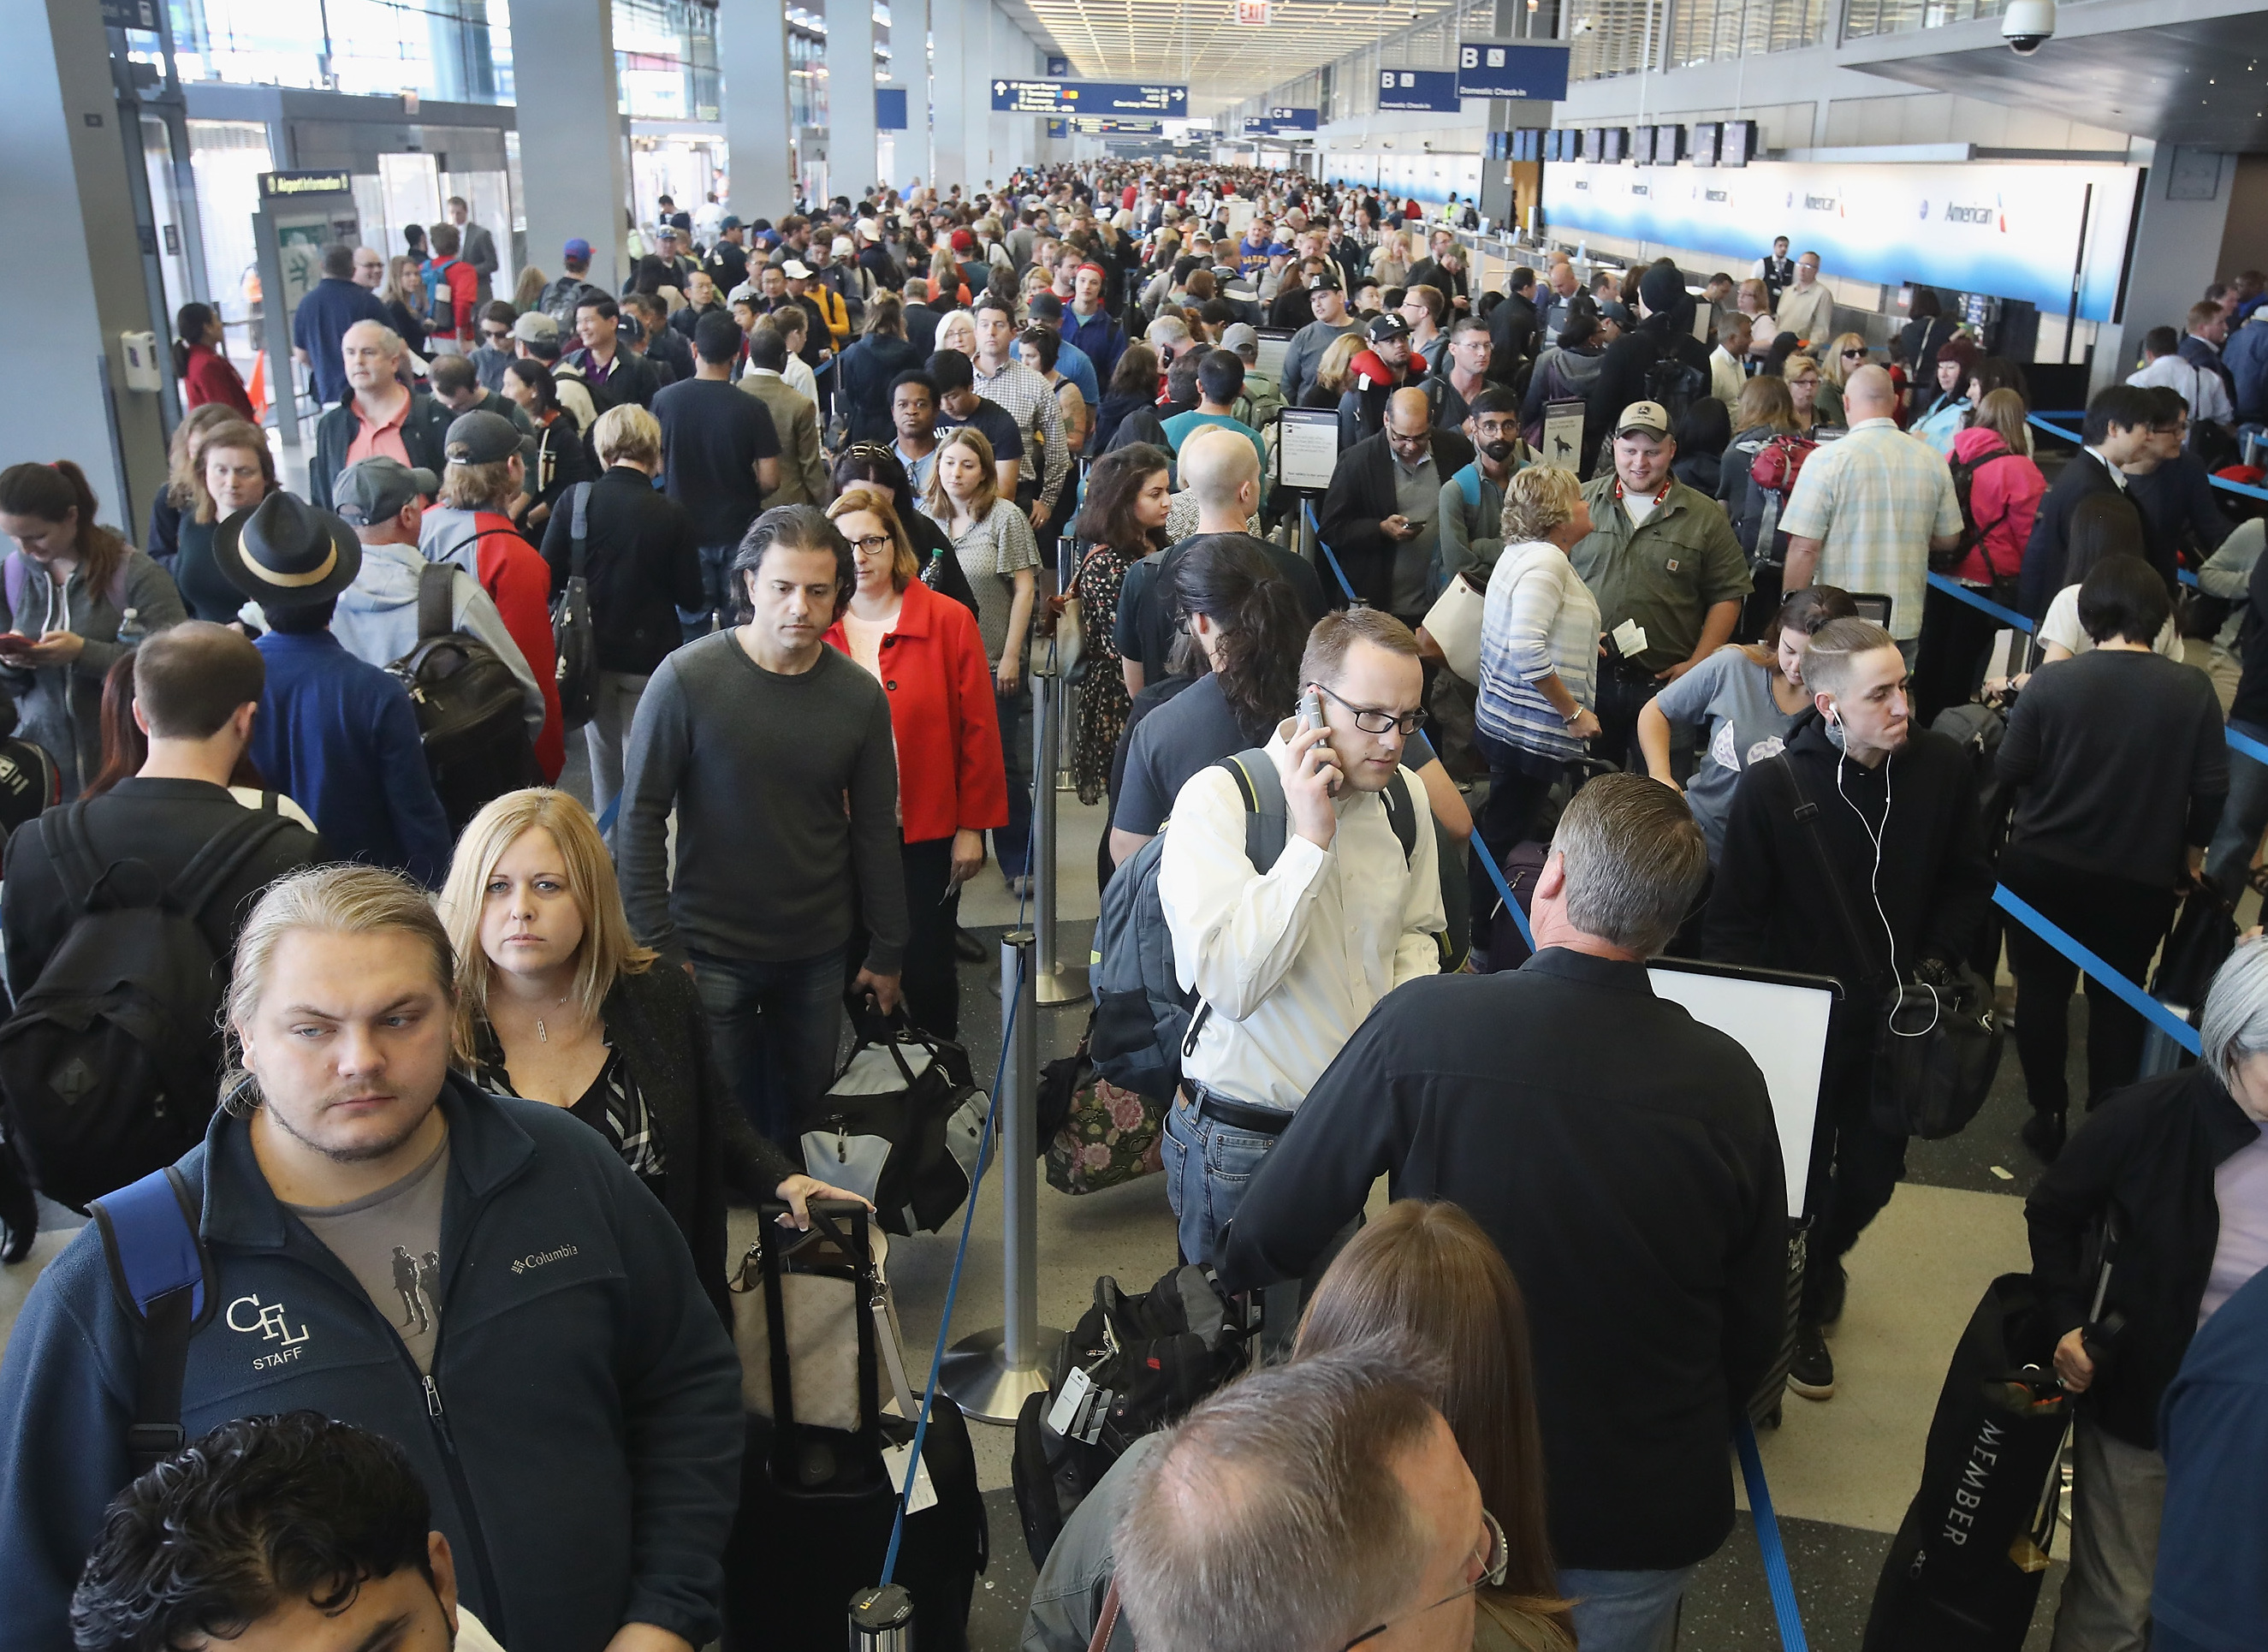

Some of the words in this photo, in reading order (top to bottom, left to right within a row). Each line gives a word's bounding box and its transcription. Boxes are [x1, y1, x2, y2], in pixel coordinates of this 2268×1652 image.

[1239, 3, 1266, 20] EXIT
[1461, 47, 1479, 68] B
[1381, 72, 1395, 88] B
[1273, 109, 1282, 118] C
[1803, 193, 1836, 211] American
[1944, 200, 1993, 225] American
[525, 1244, 579, 1269] Columbia
[226, 1293, 310, 1346] CFL
[252, 1346, 302, 1370] STAFF
[1943, 1418, 2006, 1546] MEMBER
